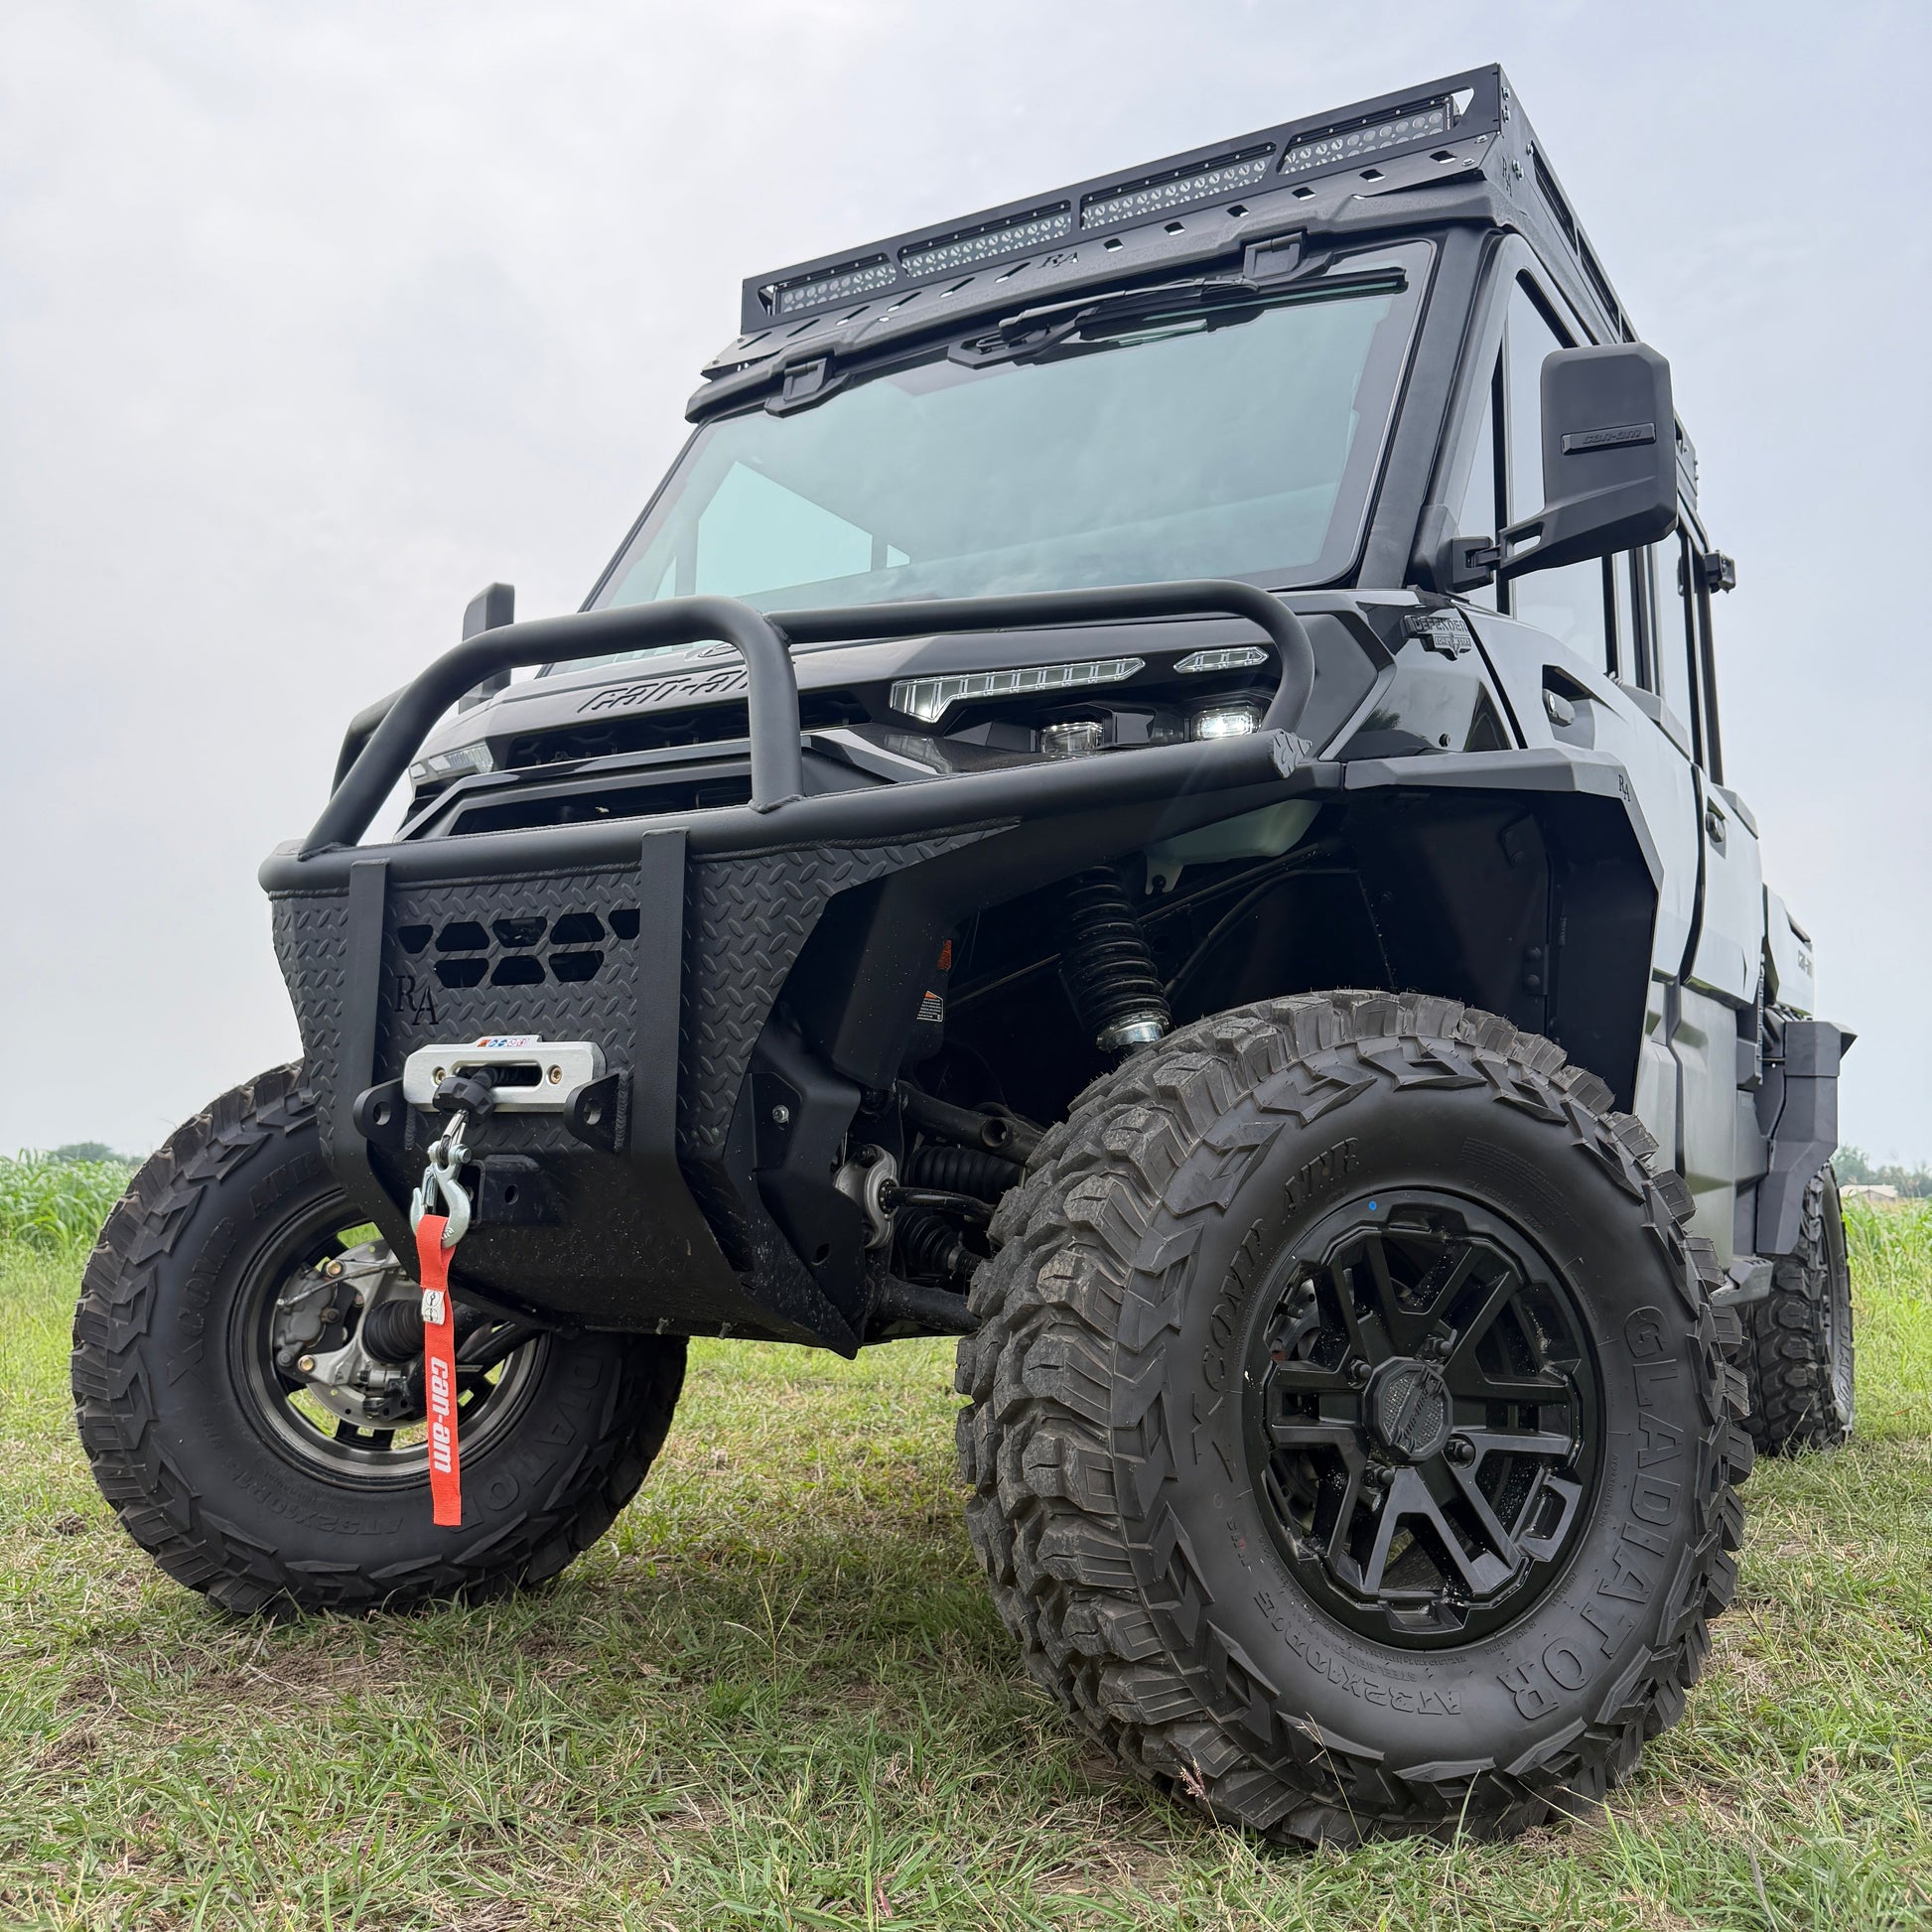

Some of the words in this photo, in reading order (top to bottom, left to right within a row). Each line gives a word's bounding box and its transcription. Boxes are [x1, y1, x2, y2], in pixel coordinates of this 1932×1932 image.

[1412, 617, 1467, 632] DEFENDER
[577, 669, 748, 713] can-a
[1618, 774, 1631, 802] RA
[394, 975, 439, 1026] RA
[431, 1356, 452, 1473] can-am
[1497, 1306, 1684, 1722] GLADIATOR
